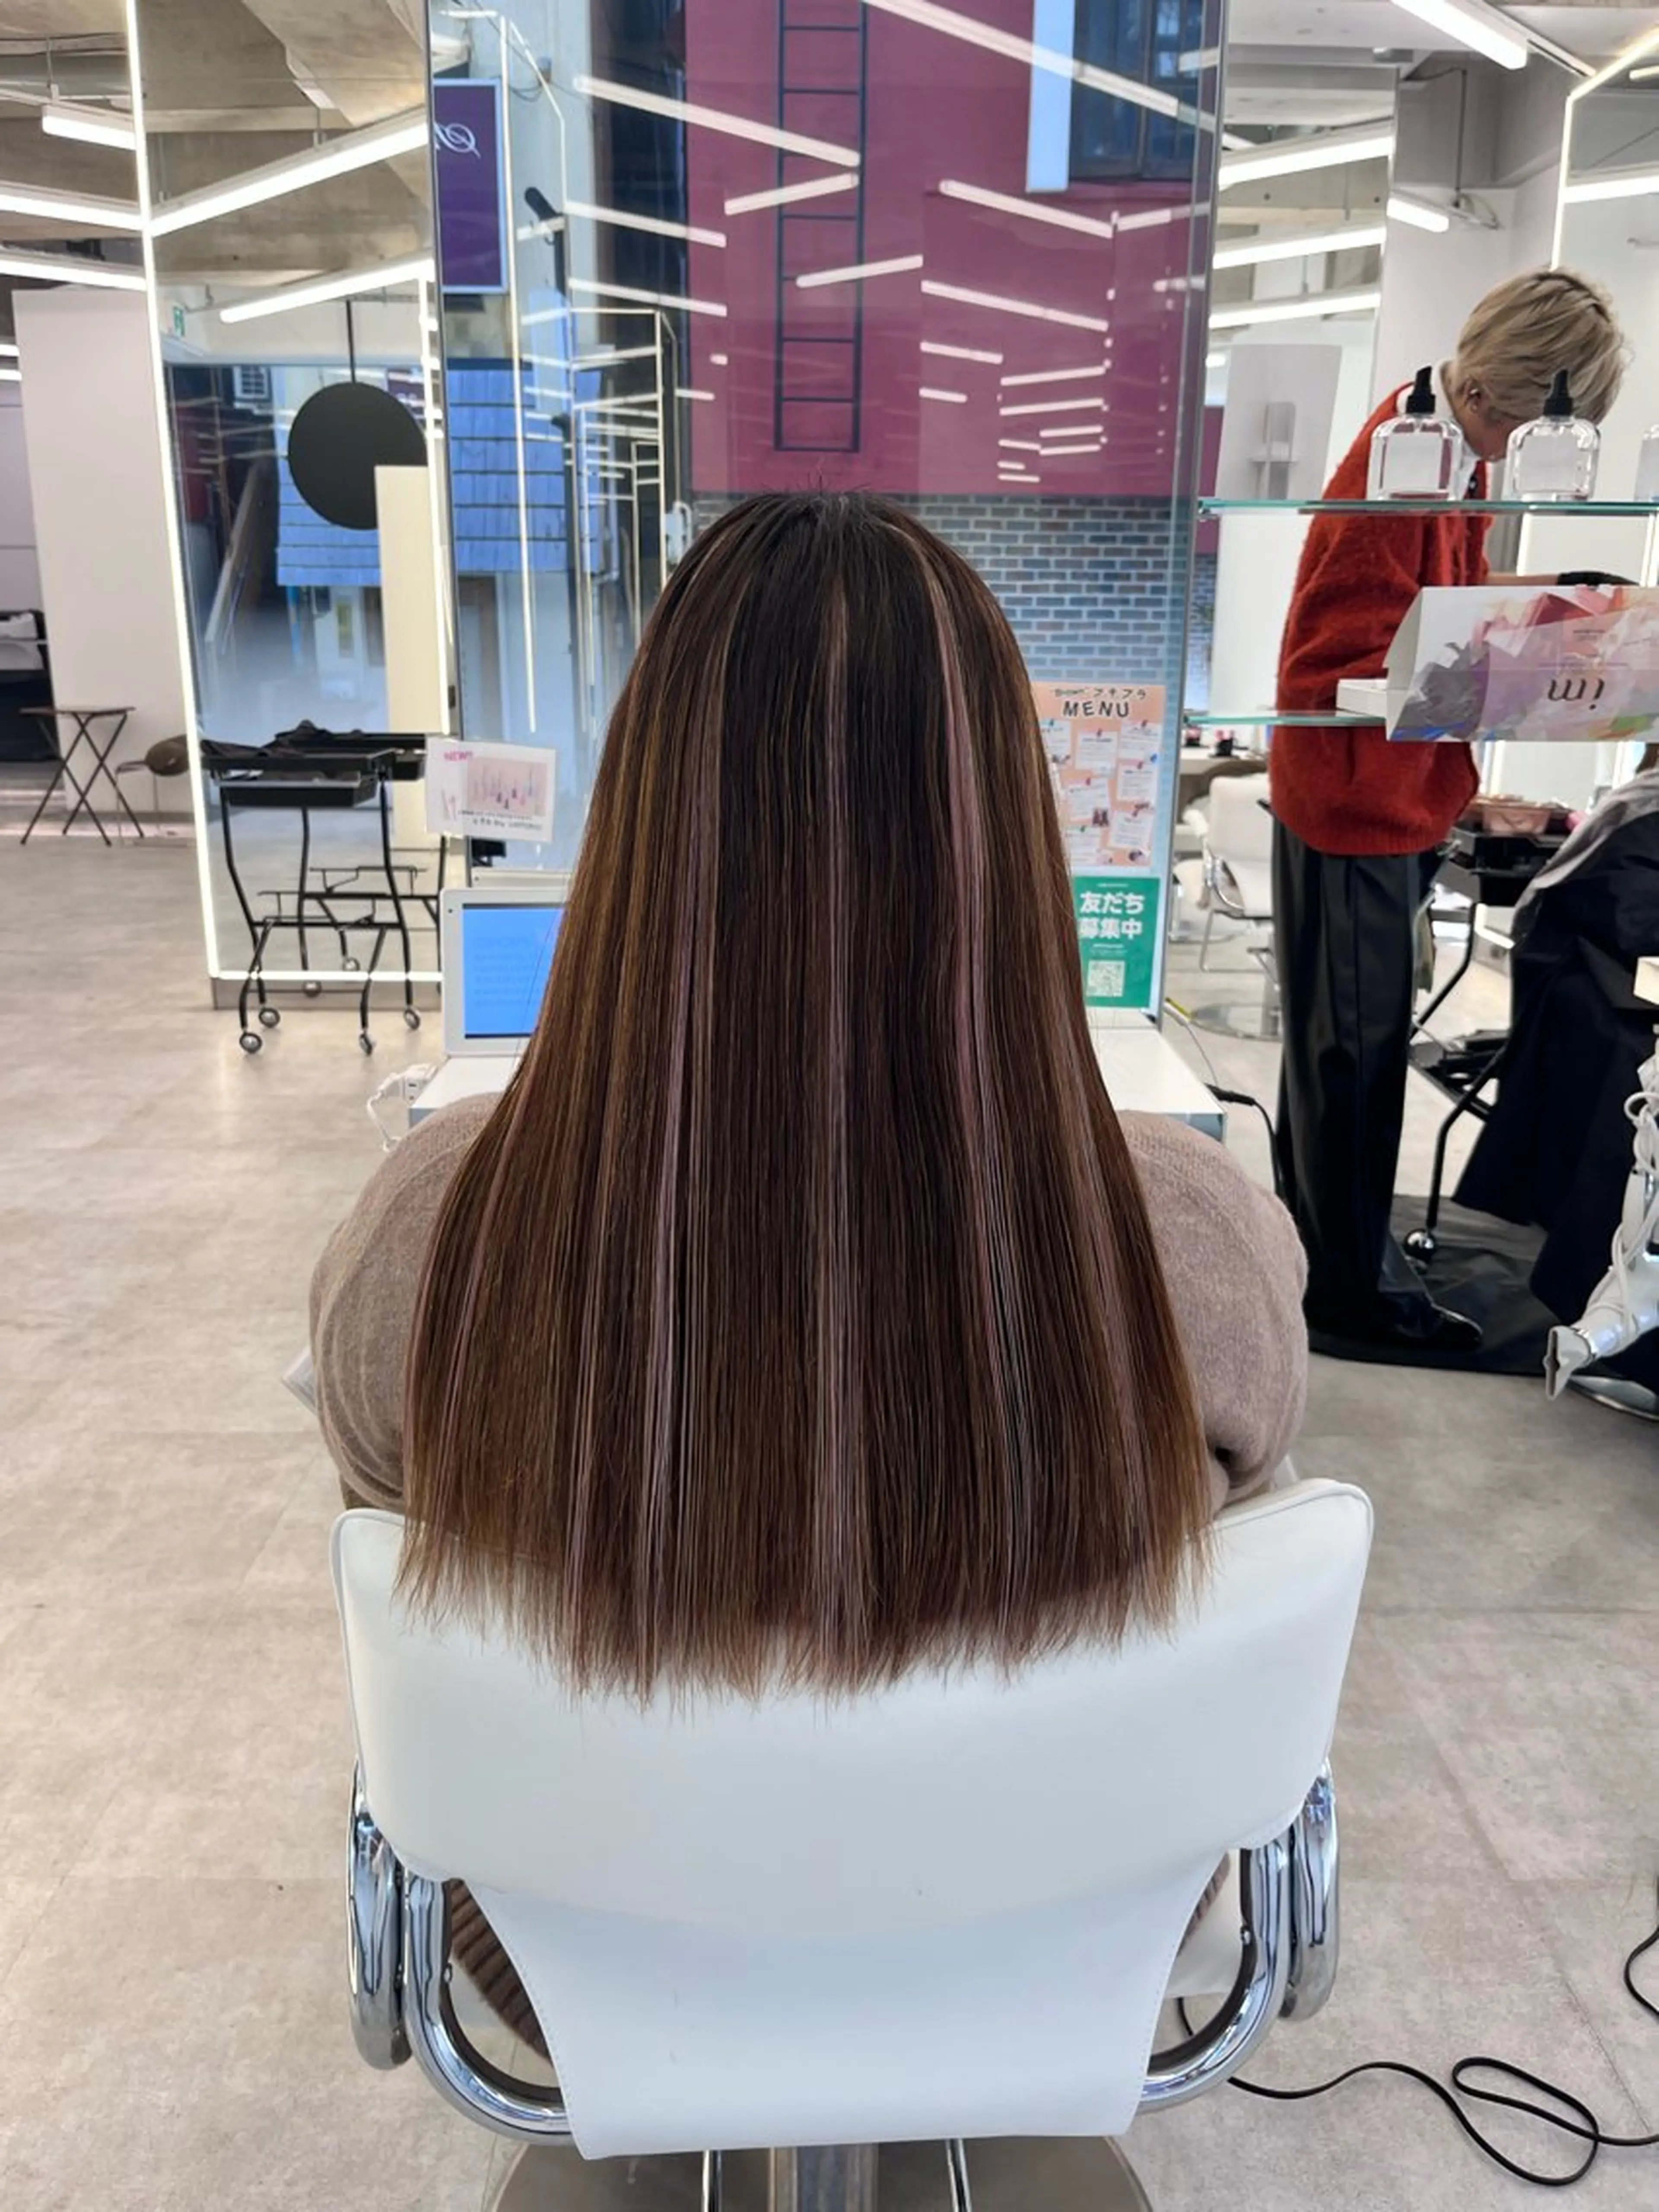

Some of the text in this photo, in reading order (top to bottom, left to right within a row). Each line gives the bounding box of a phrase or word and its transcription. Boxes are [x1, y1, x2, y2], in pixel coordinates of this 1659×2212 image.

[1062, 700, 1129, 718] MENU
[1080, 891, 1145, 914] 友だち
[1077, 917, 1142, 939] 募集中
